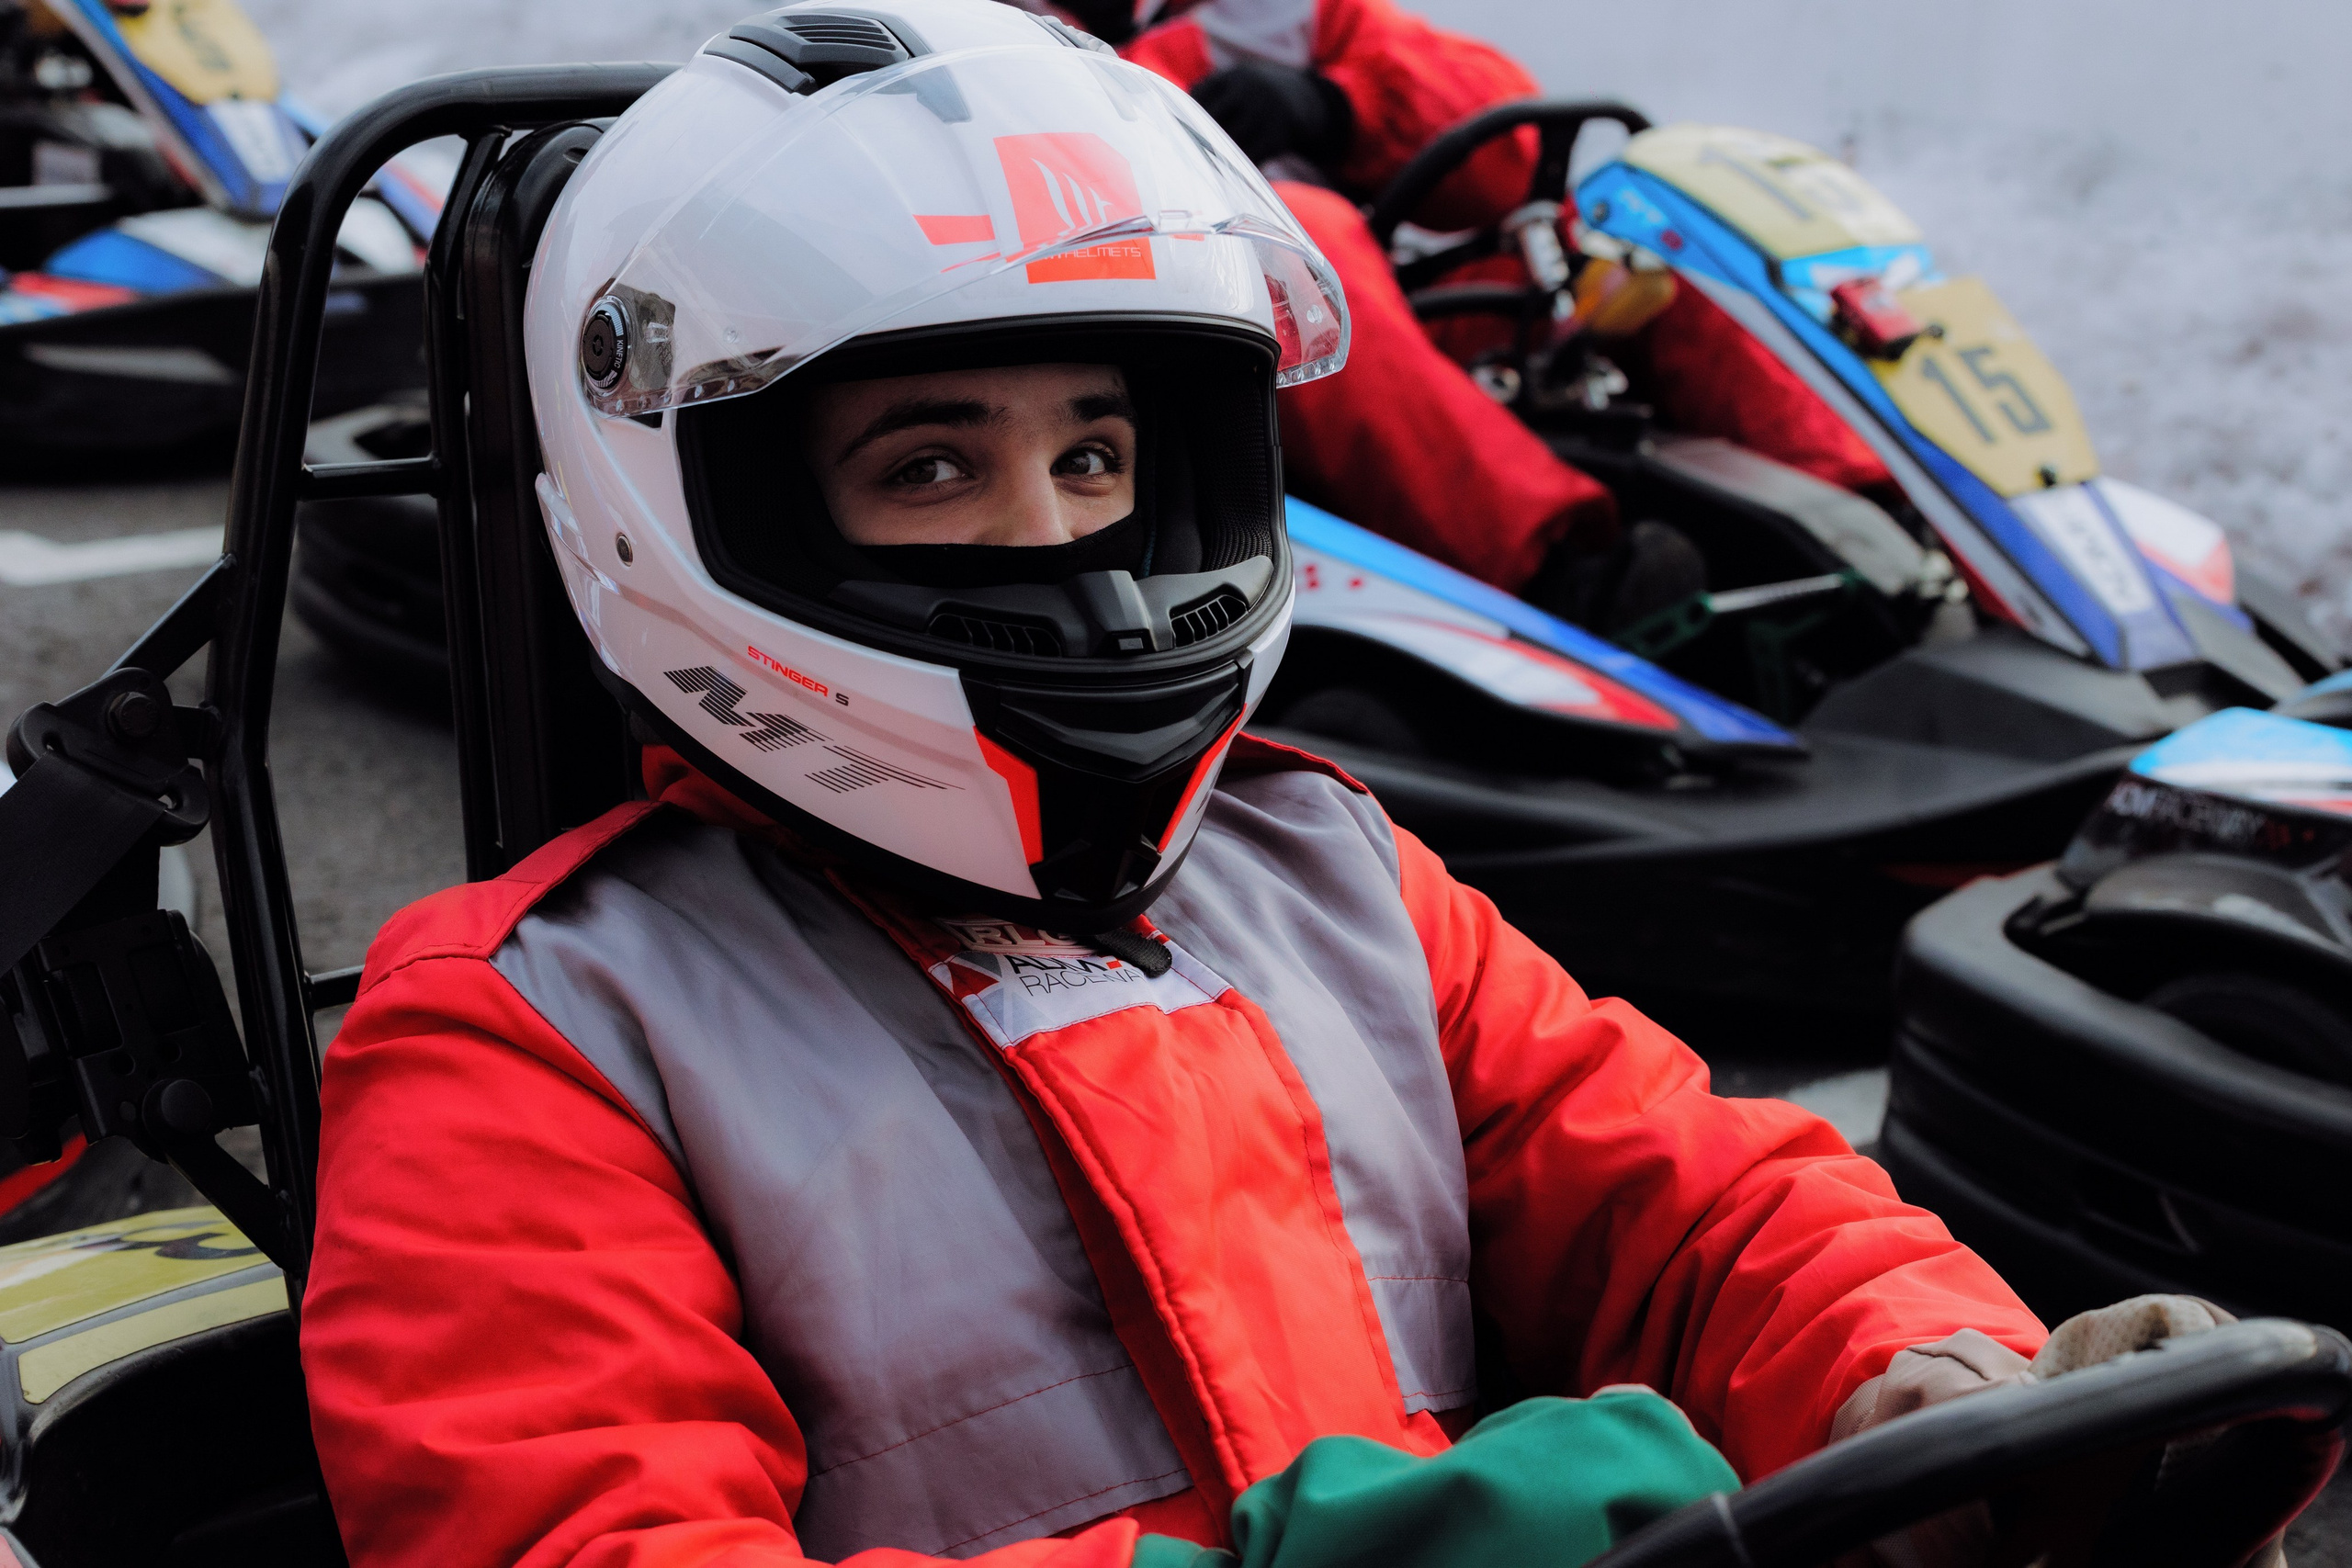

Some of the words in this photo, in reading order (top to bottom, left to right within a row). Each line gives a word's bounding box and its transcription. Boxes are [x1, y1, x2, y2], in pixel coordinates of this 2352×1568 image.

[614, 339, 624, 368] KINETIC
[1921, 344, 2052, 446] 15
[747, 645, 829, 697] STINGER
[835, 693, 850, 706] S
